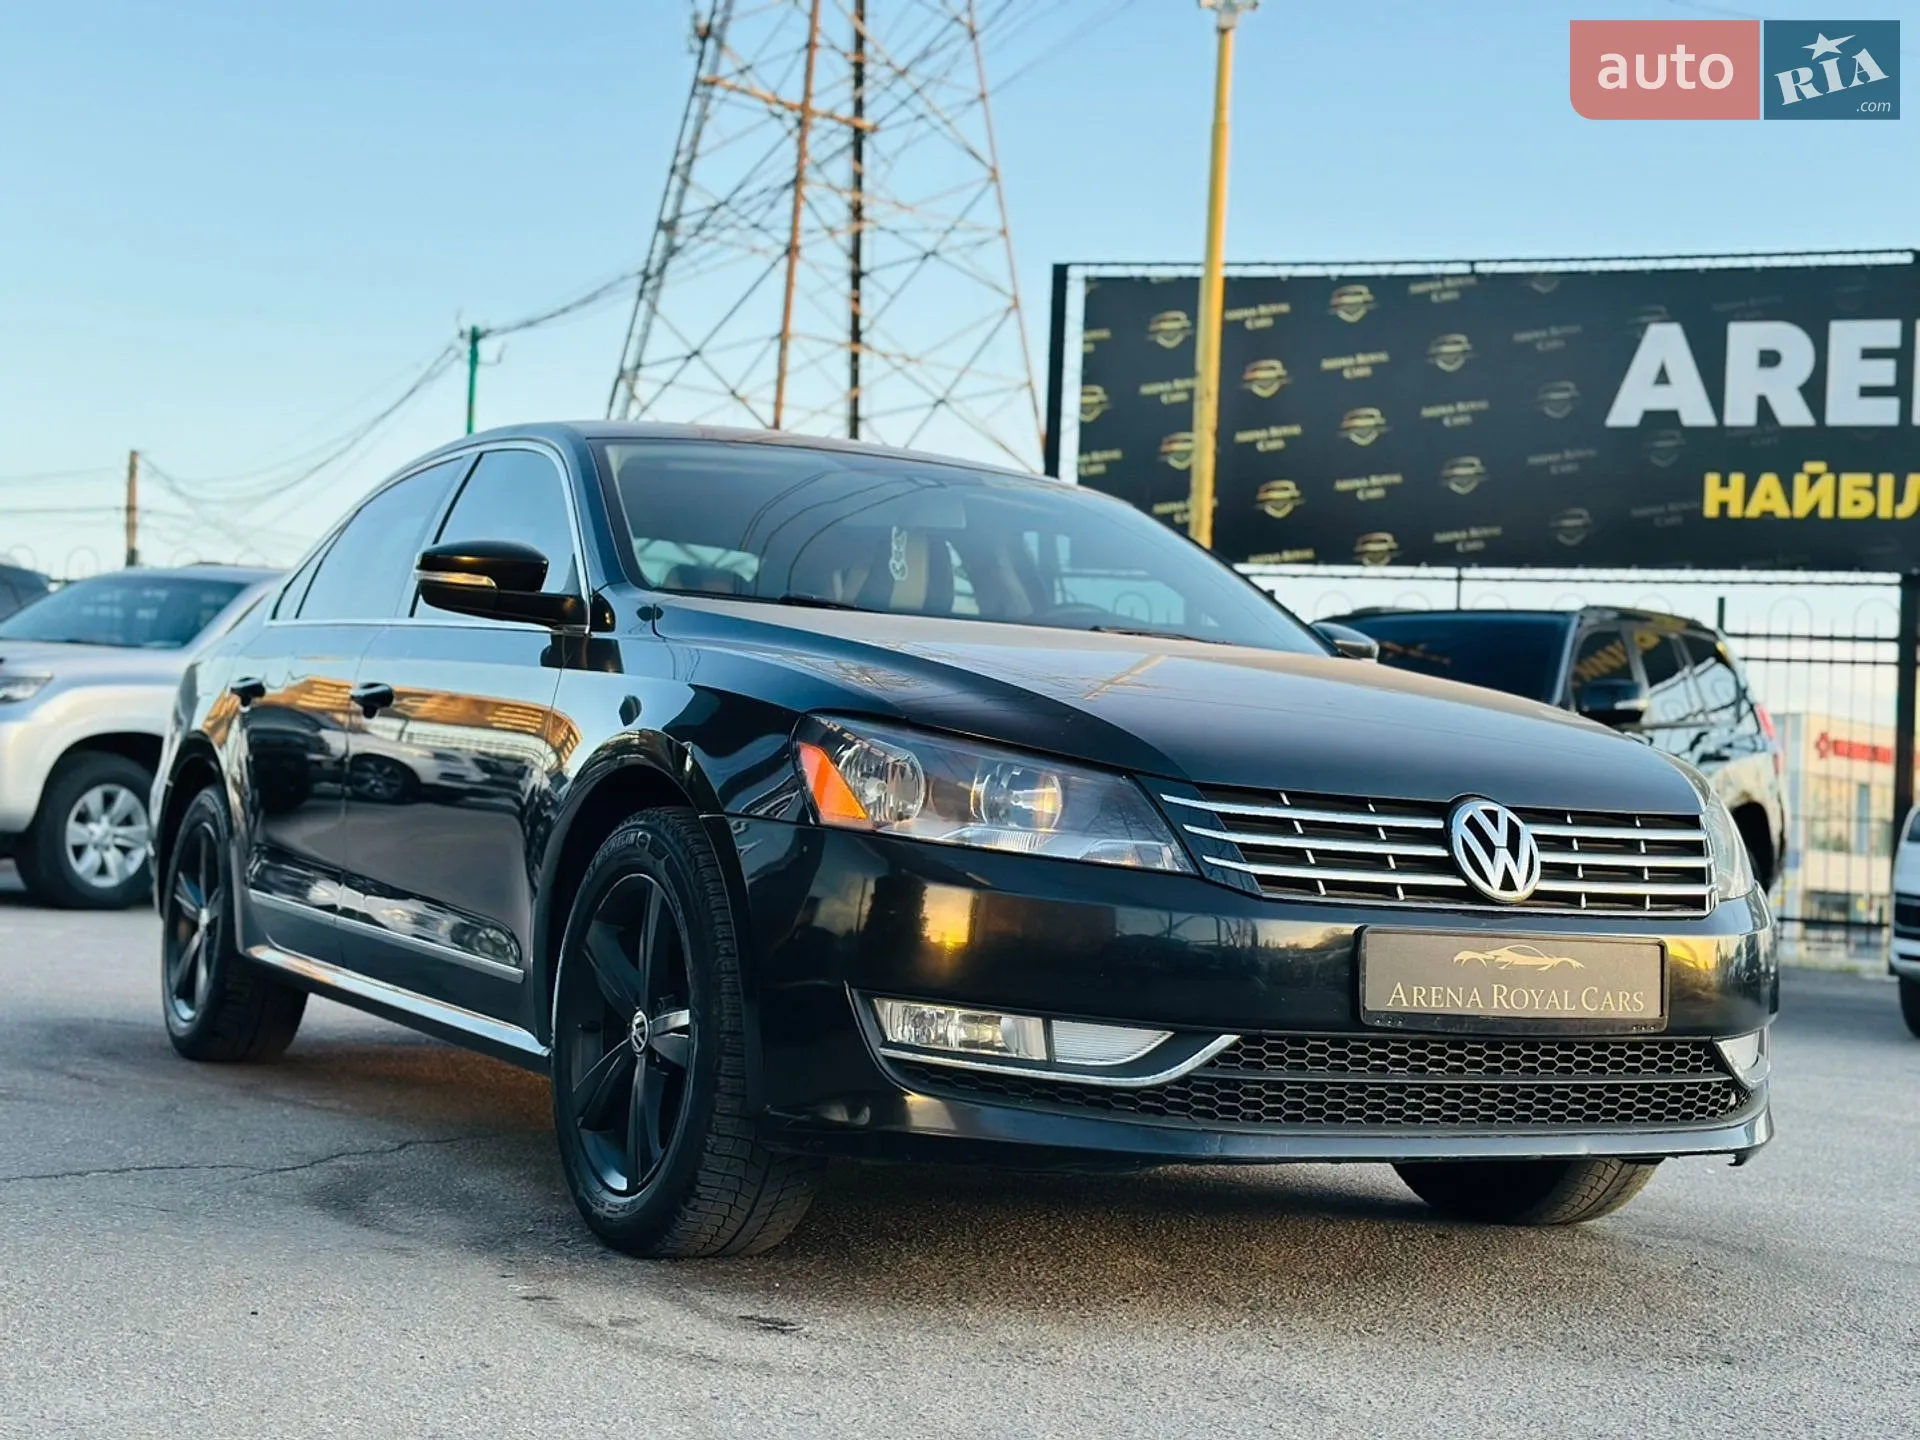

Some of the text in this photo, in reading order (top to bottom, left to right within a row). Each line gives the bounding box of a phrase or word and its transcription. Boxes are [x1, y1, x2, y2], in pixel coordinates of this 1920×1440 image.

[1604, 319, 1920, 428] ARE
[1386, 981, 1646, 1013] ARENA ROYAL CARS
